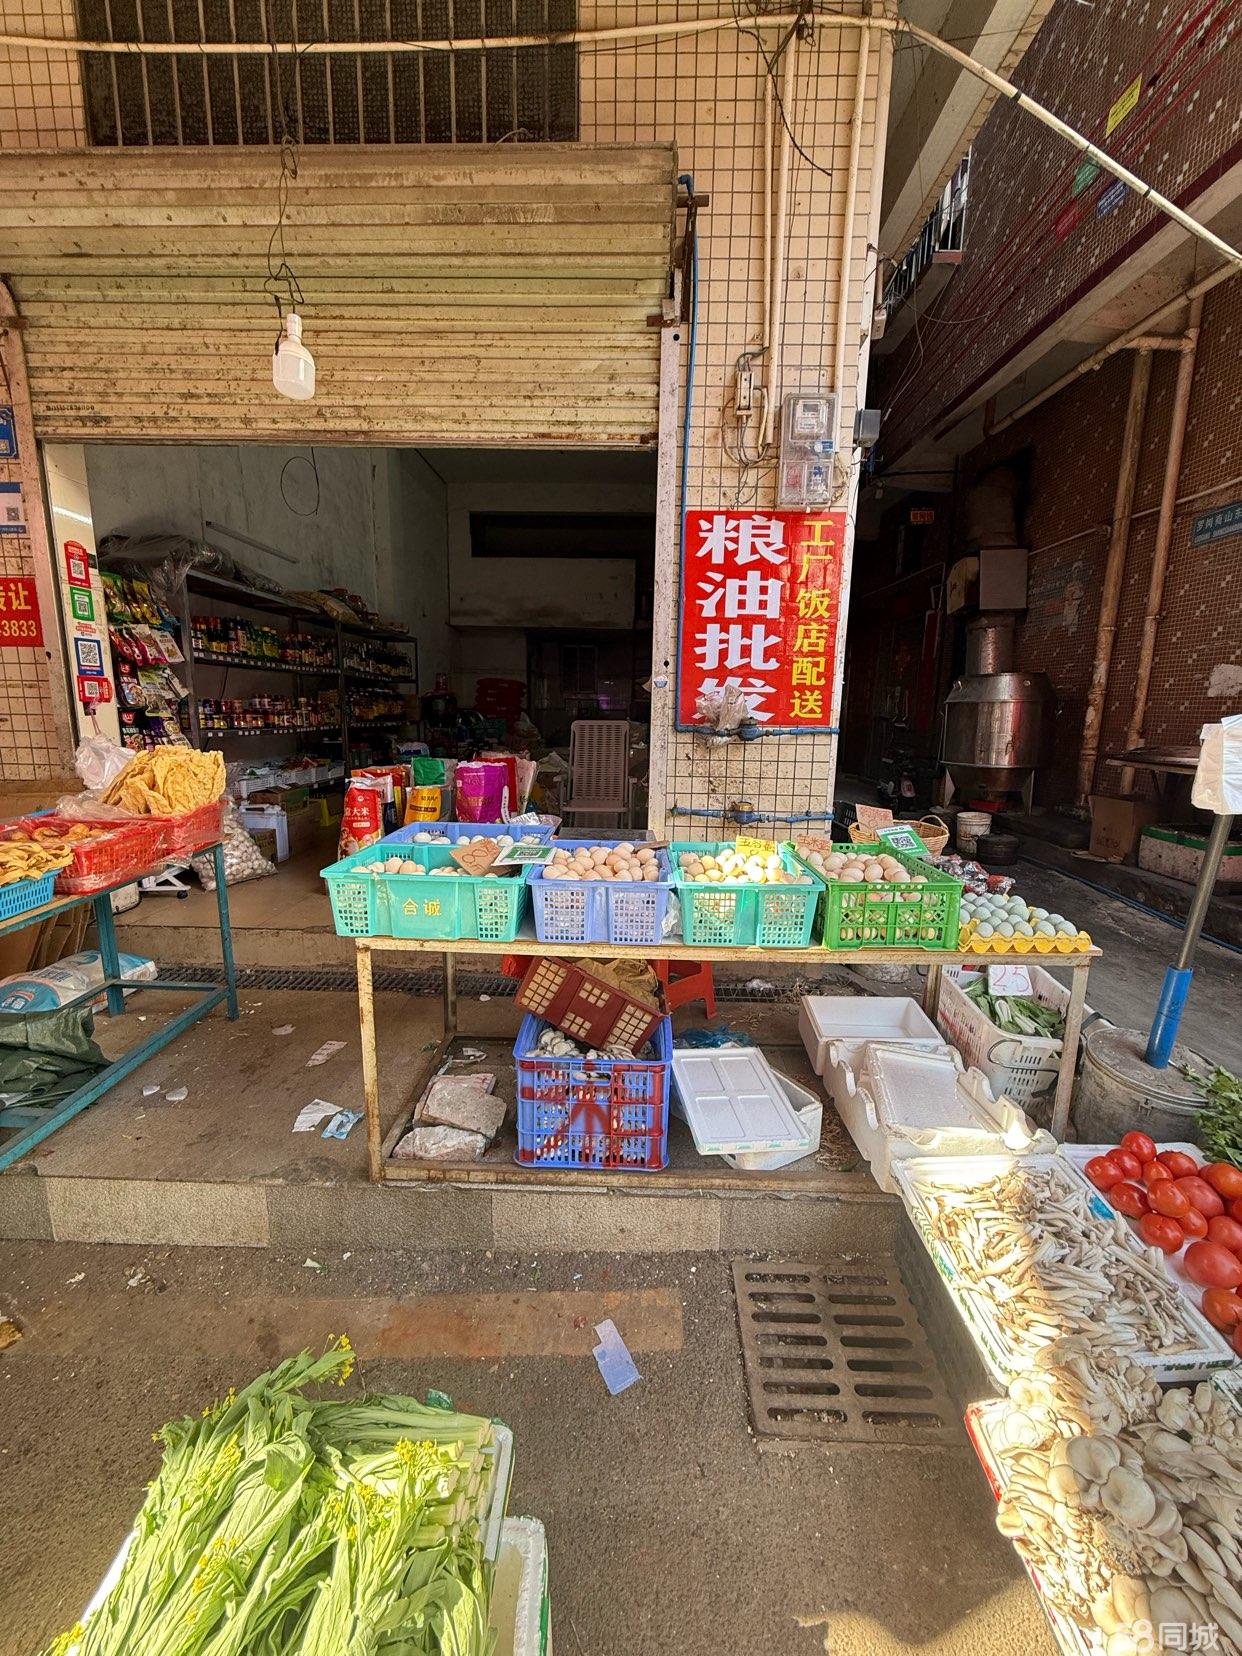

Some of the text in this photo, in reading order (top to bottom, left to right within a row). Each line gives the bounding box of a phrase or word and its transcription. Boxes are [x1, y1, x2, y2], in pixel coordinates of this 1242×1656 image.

[0, 620, 37, 637] 3833
[790, 519, 835, 719] 工厂饭店配送
